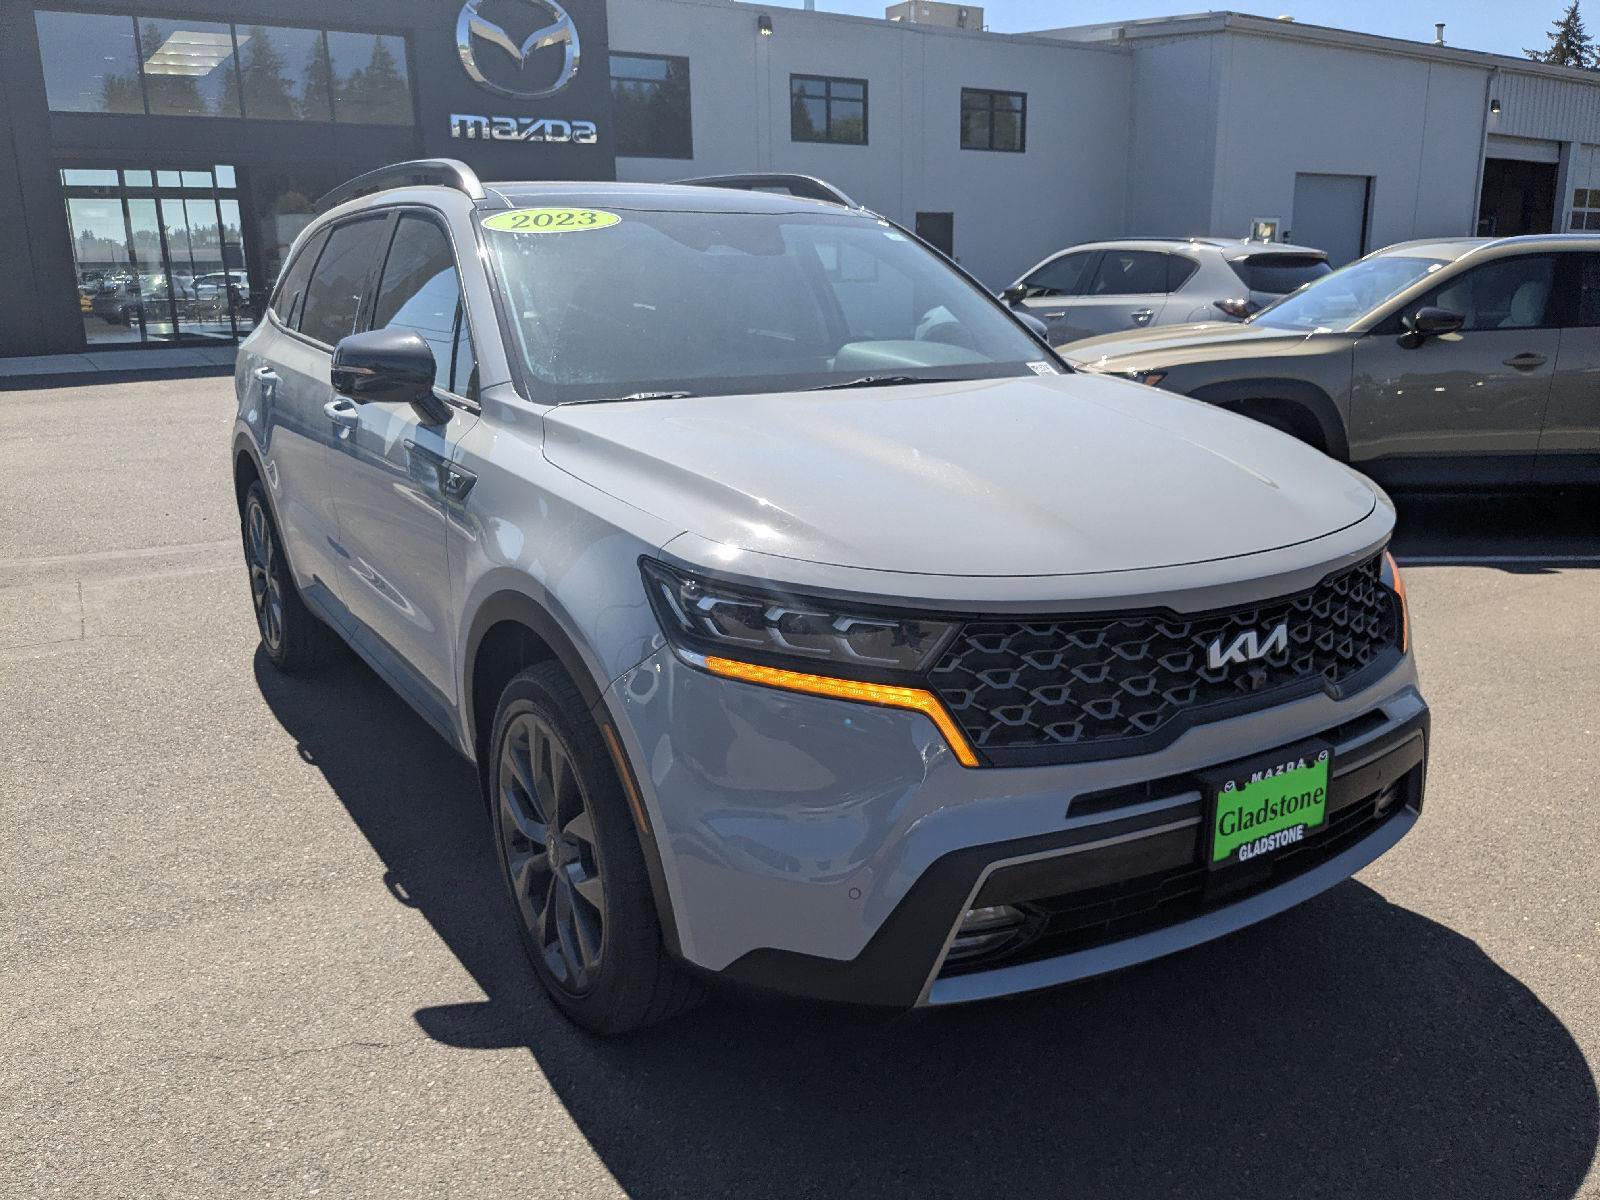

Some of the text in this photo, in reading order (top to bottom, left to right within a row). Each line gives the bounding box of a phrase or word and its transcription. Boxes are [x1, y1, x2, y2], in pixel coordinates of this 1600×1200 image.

[511, 212, 597, 228] 2023
[1209, 623, 1287, 669] KIA
[1251, 758, 1306, 784] MAZDA
[1218, 786, 1324, 836] Gladstone
[1238, 824, 1304, 862] GLADSTONE
